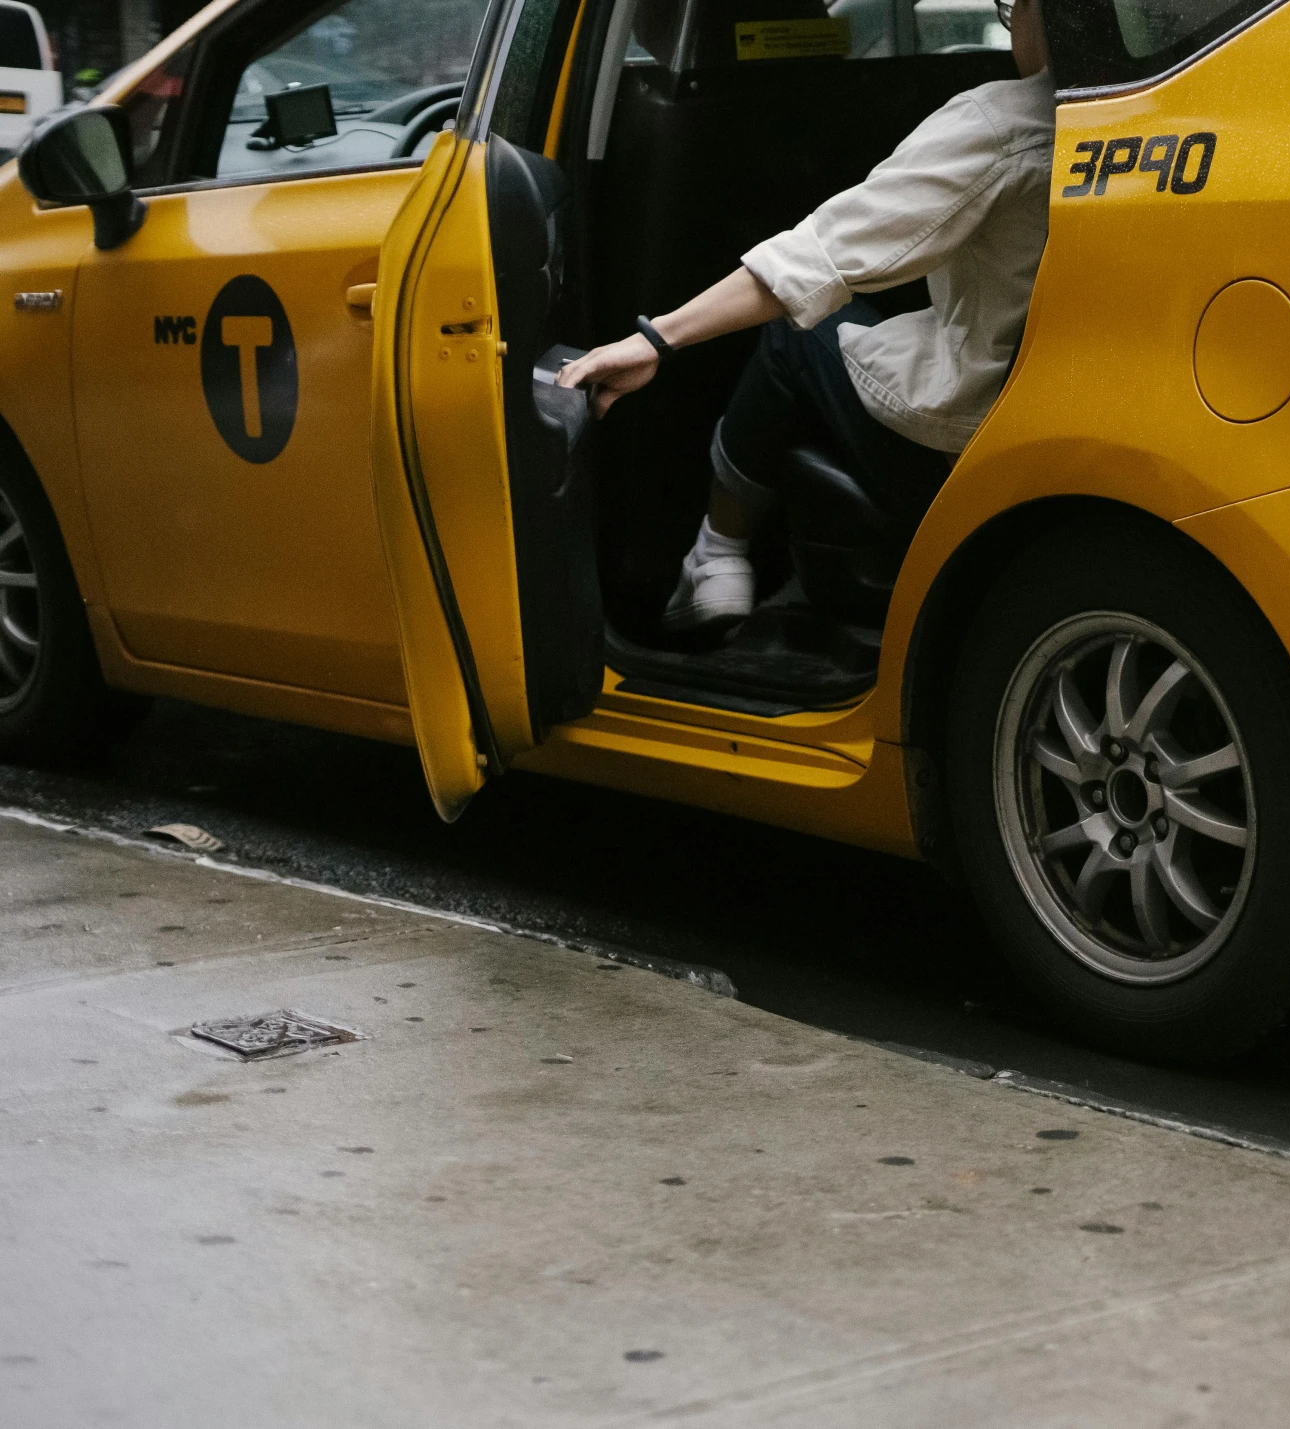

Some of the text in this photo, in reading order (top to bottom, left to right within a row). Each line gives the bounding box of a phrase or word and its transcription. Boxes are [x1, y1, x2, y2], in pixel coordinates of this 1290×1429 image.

[1061, 132, 1217, 198] 3P90
[154, 315, 273, 438] NYC T
